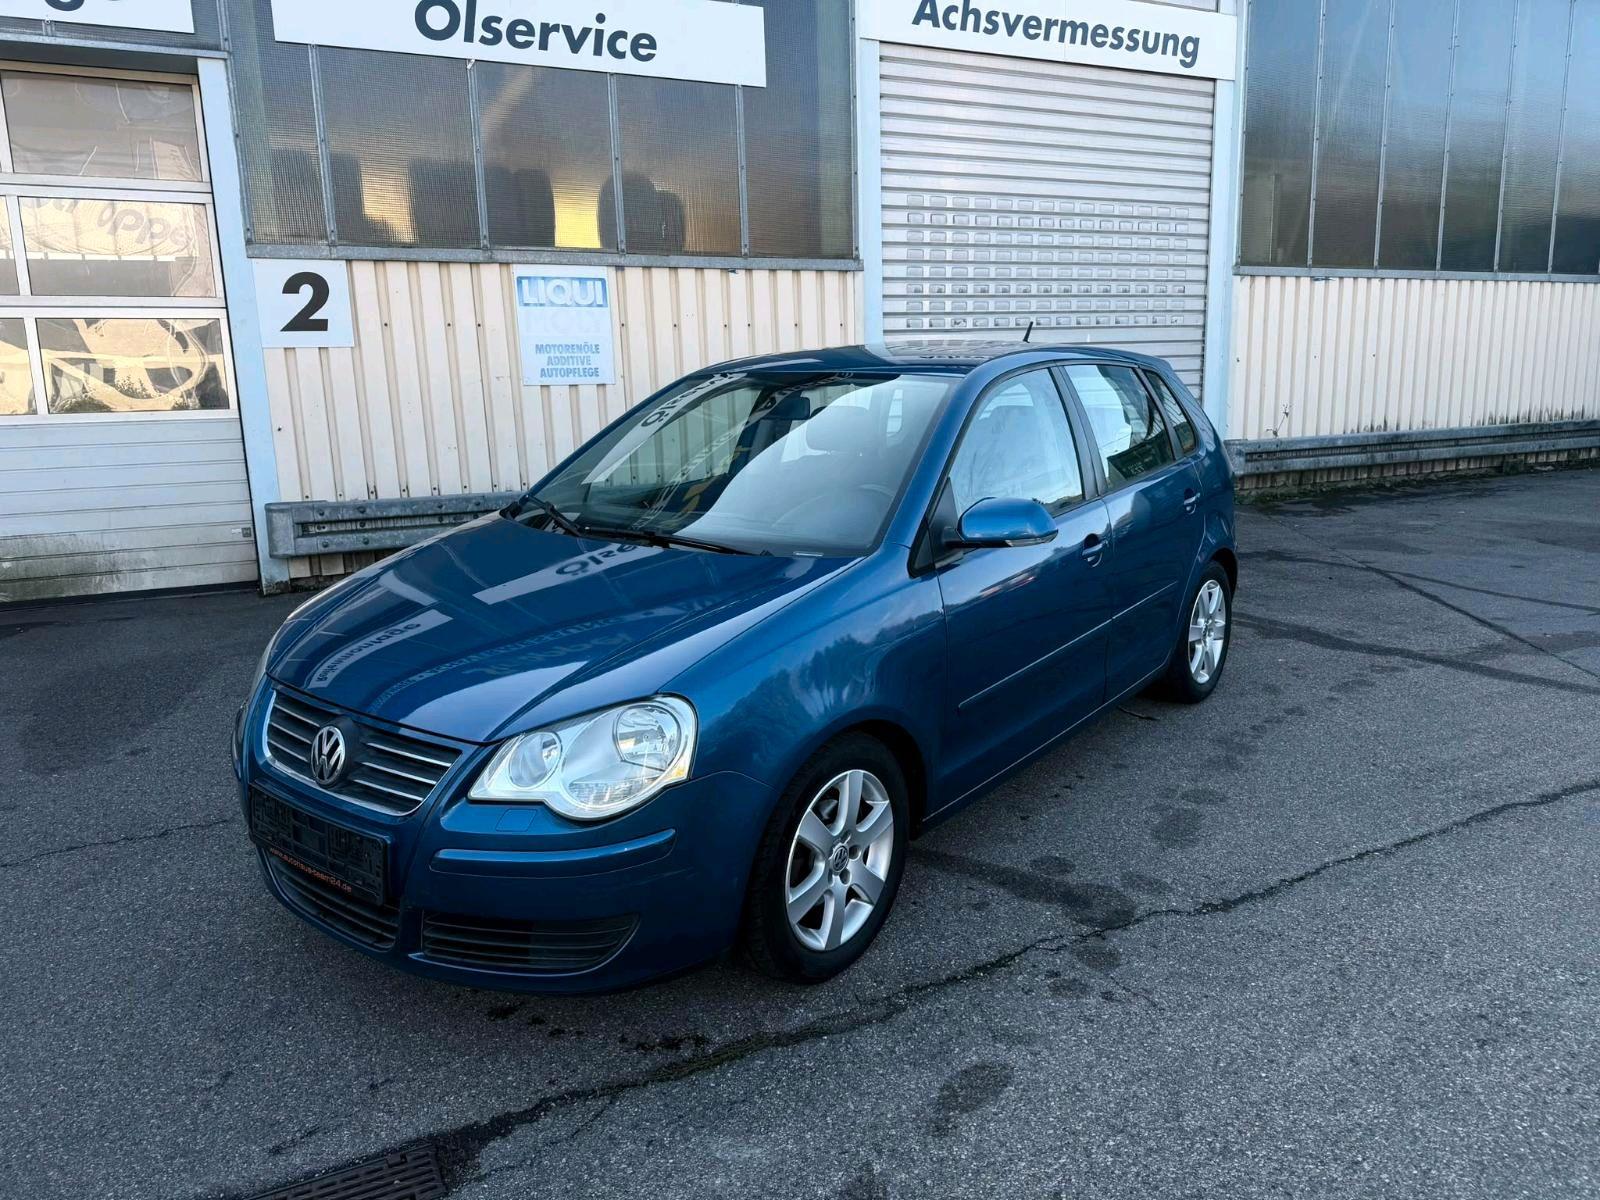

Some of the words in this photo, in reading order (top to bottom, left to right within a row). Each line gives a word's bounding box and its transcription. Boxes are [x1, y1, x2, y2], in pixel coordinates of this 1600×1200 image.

[911, 0, 1200, 69] Achsvermessung
[280, 271, 330, 332] 2
[521, 279, 604, 306] LIQUI
[535, 342, 600, 354] MOTORENÖLE
[546, 355, 592, 366] ADDITIVE
[539, 367, 600, 378] AUTOPFLEGE
